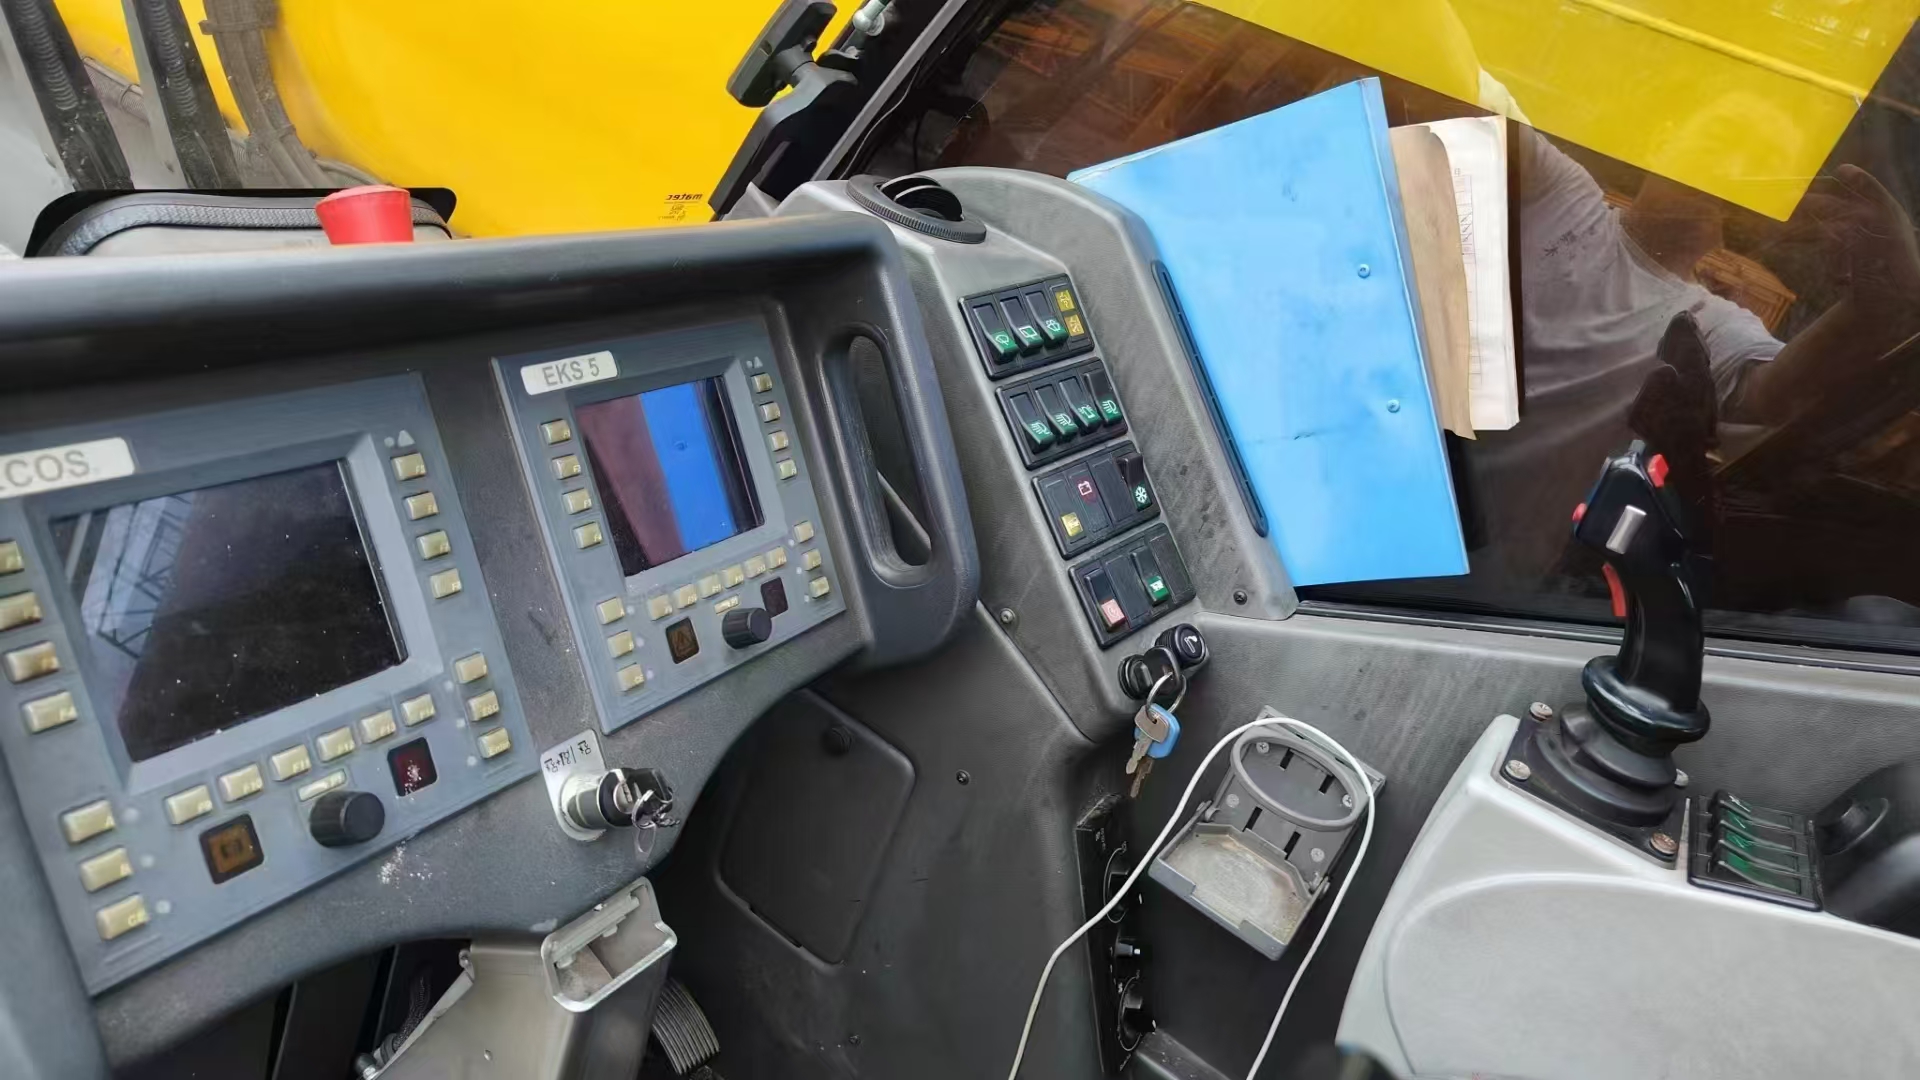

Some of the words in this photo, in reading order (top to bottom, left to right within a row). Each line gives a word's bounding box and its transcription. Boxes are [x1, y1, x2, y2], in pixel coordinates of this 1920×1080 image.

[542, 361, 584, 387] EKS
[588, 358, 600, 377] 5
[0, 450, 90, 491] COS
